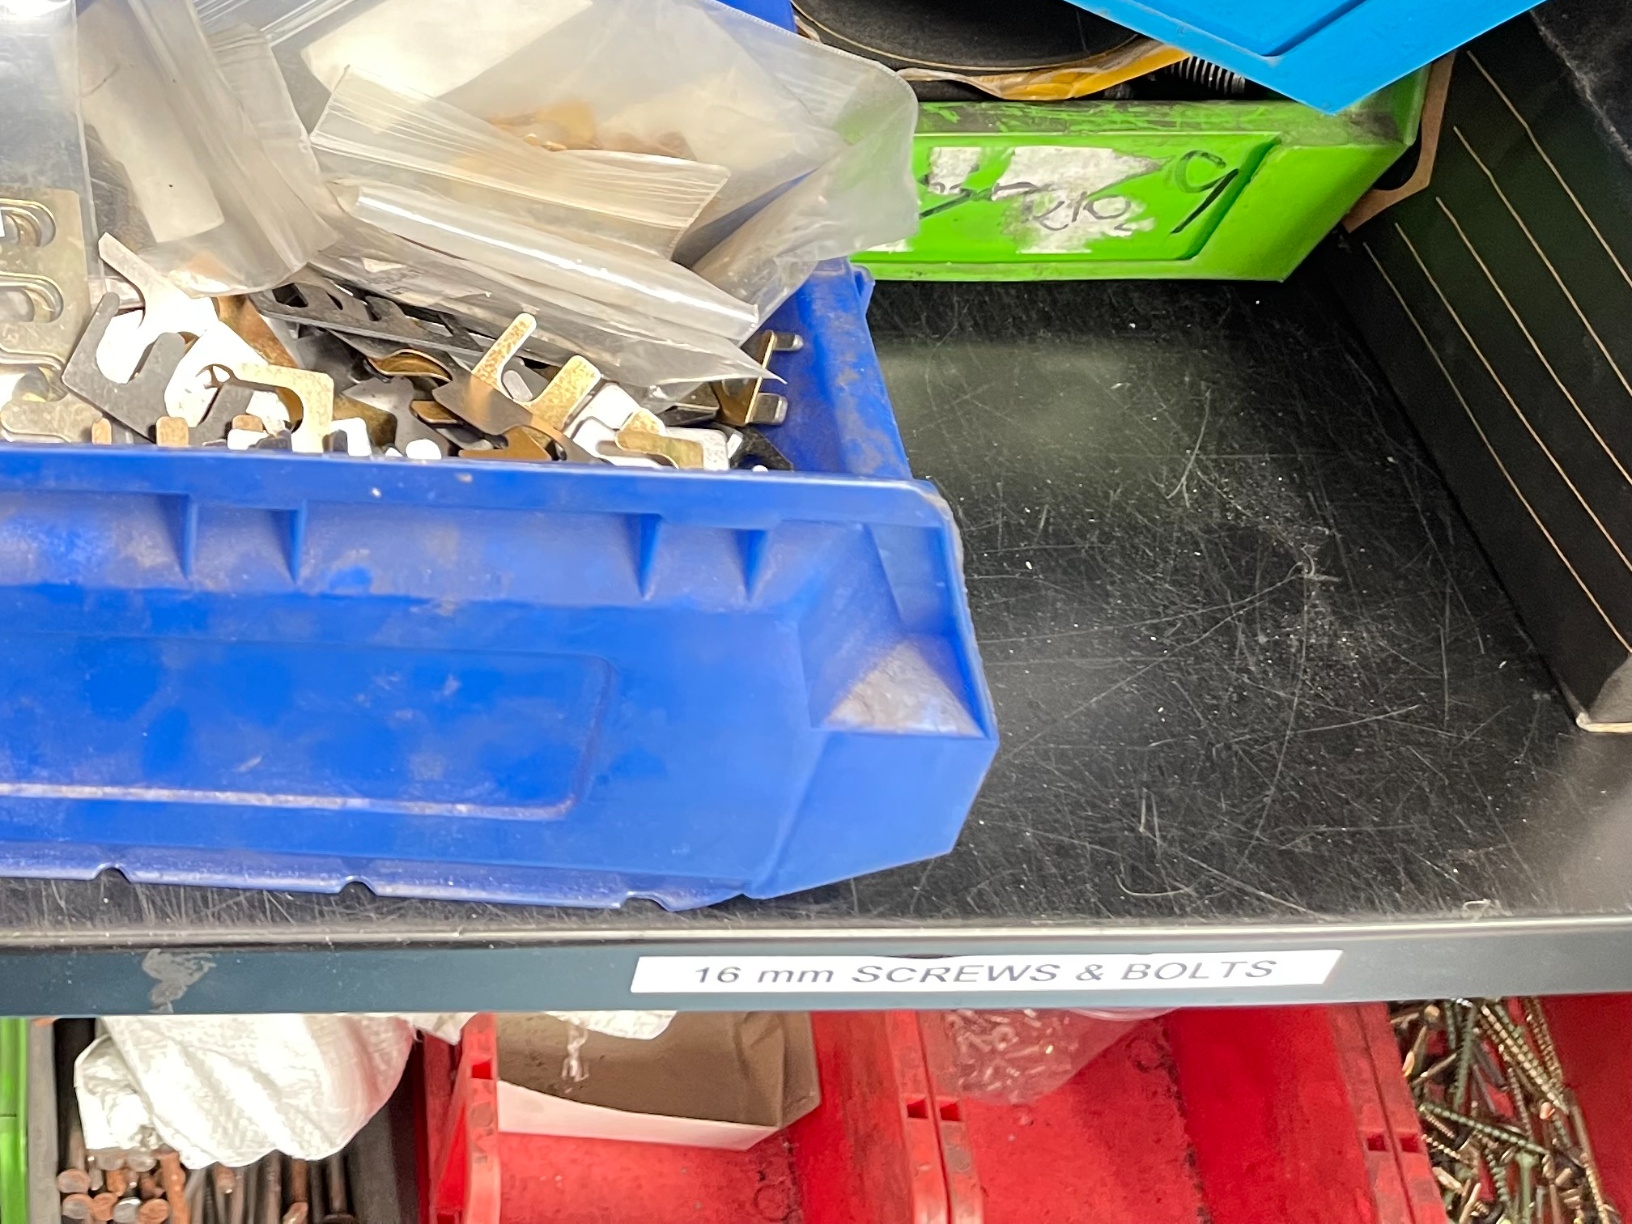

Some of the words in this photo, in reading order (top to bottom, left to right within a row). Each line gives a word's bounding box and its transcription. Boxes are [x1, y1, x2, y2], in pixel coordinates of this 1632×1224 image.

[695, 966, 742, 984] 16
[757, 968, 835, 984] mm
[851, 962, 1061, 984] SCREWS
[1074, 963, 1106, 982] &
[1120, 959, 1278, 981] BOLTS
